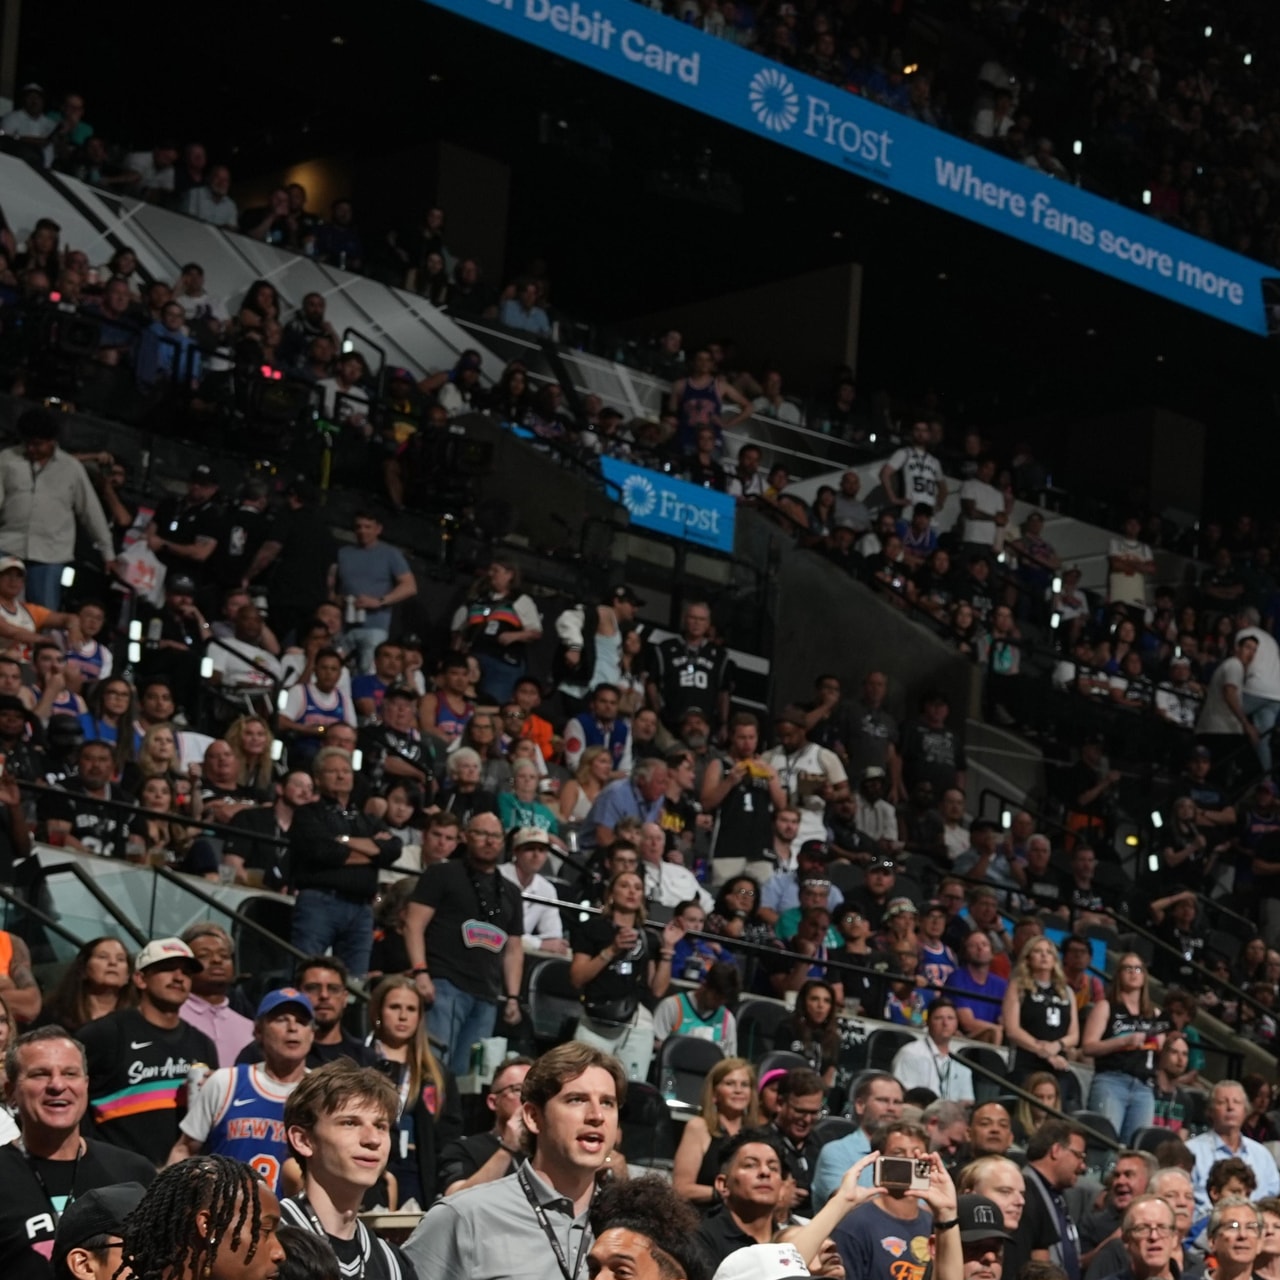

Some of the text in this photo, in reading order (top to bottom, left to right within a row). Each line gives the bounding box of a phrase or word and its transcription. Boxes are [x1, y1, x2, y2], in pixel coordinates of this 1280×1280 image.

[523, 0, 700, 86] Debit Card
[803, 94, 894, 169] Frost
[934, 155, 1026, 219] Where
[1031, 191, 1095, 247] fans
[1099, 229, 1174, 278] score
[1177, 254, 1244, 305] more
[659, 489, 721, 535] Frost
[127, 1060, 159, 1085] San
[227, 1117, 270, 1141] NEW
